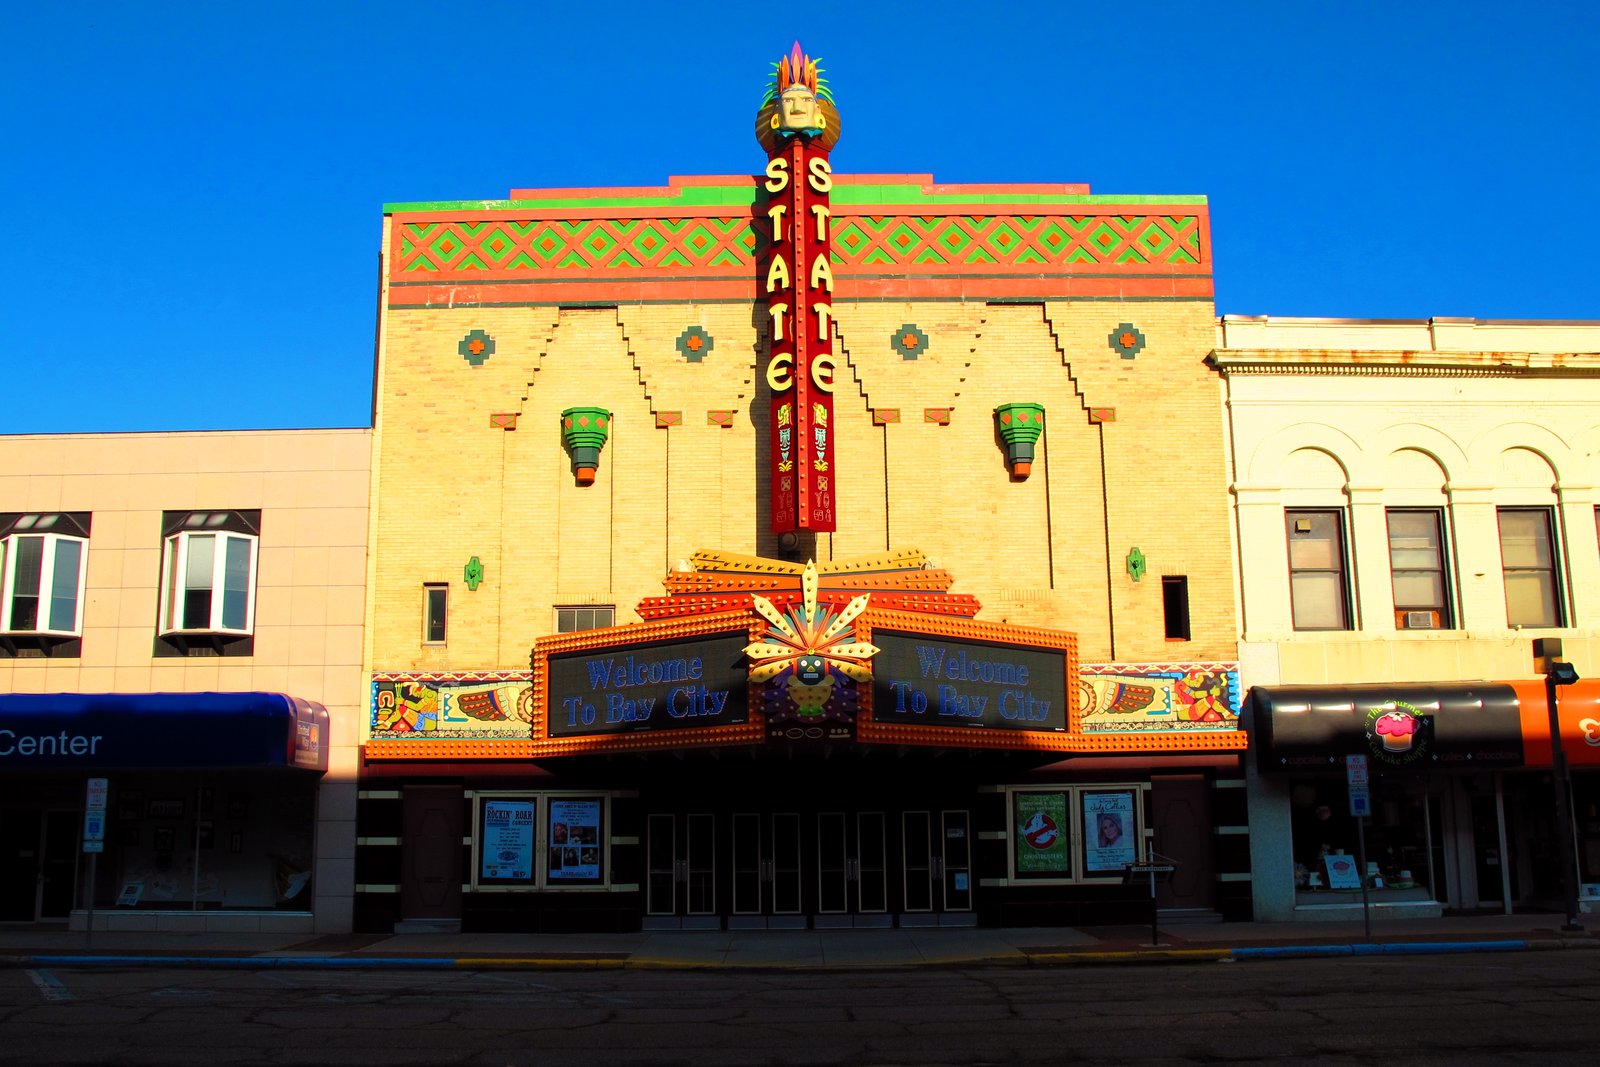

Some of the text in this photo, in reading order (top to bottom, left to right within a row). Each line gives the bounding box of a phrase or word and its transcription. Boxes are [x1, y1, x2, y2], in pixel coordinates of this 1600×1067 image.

[765, 157, 793, 392] STATE
[808, 156, 837, 393] STATE
[586, 656, 704, 690] Welcome
[915, 645, 1030, 686] Welcome
[562, 685, 730, 727] To Bay City
[888, 679, 1052, 722] To Bay City
[1366, 706, 1383, 720] The
[0, 729, 103, 757] Center
[515, 809, 532, 820] ROAR
